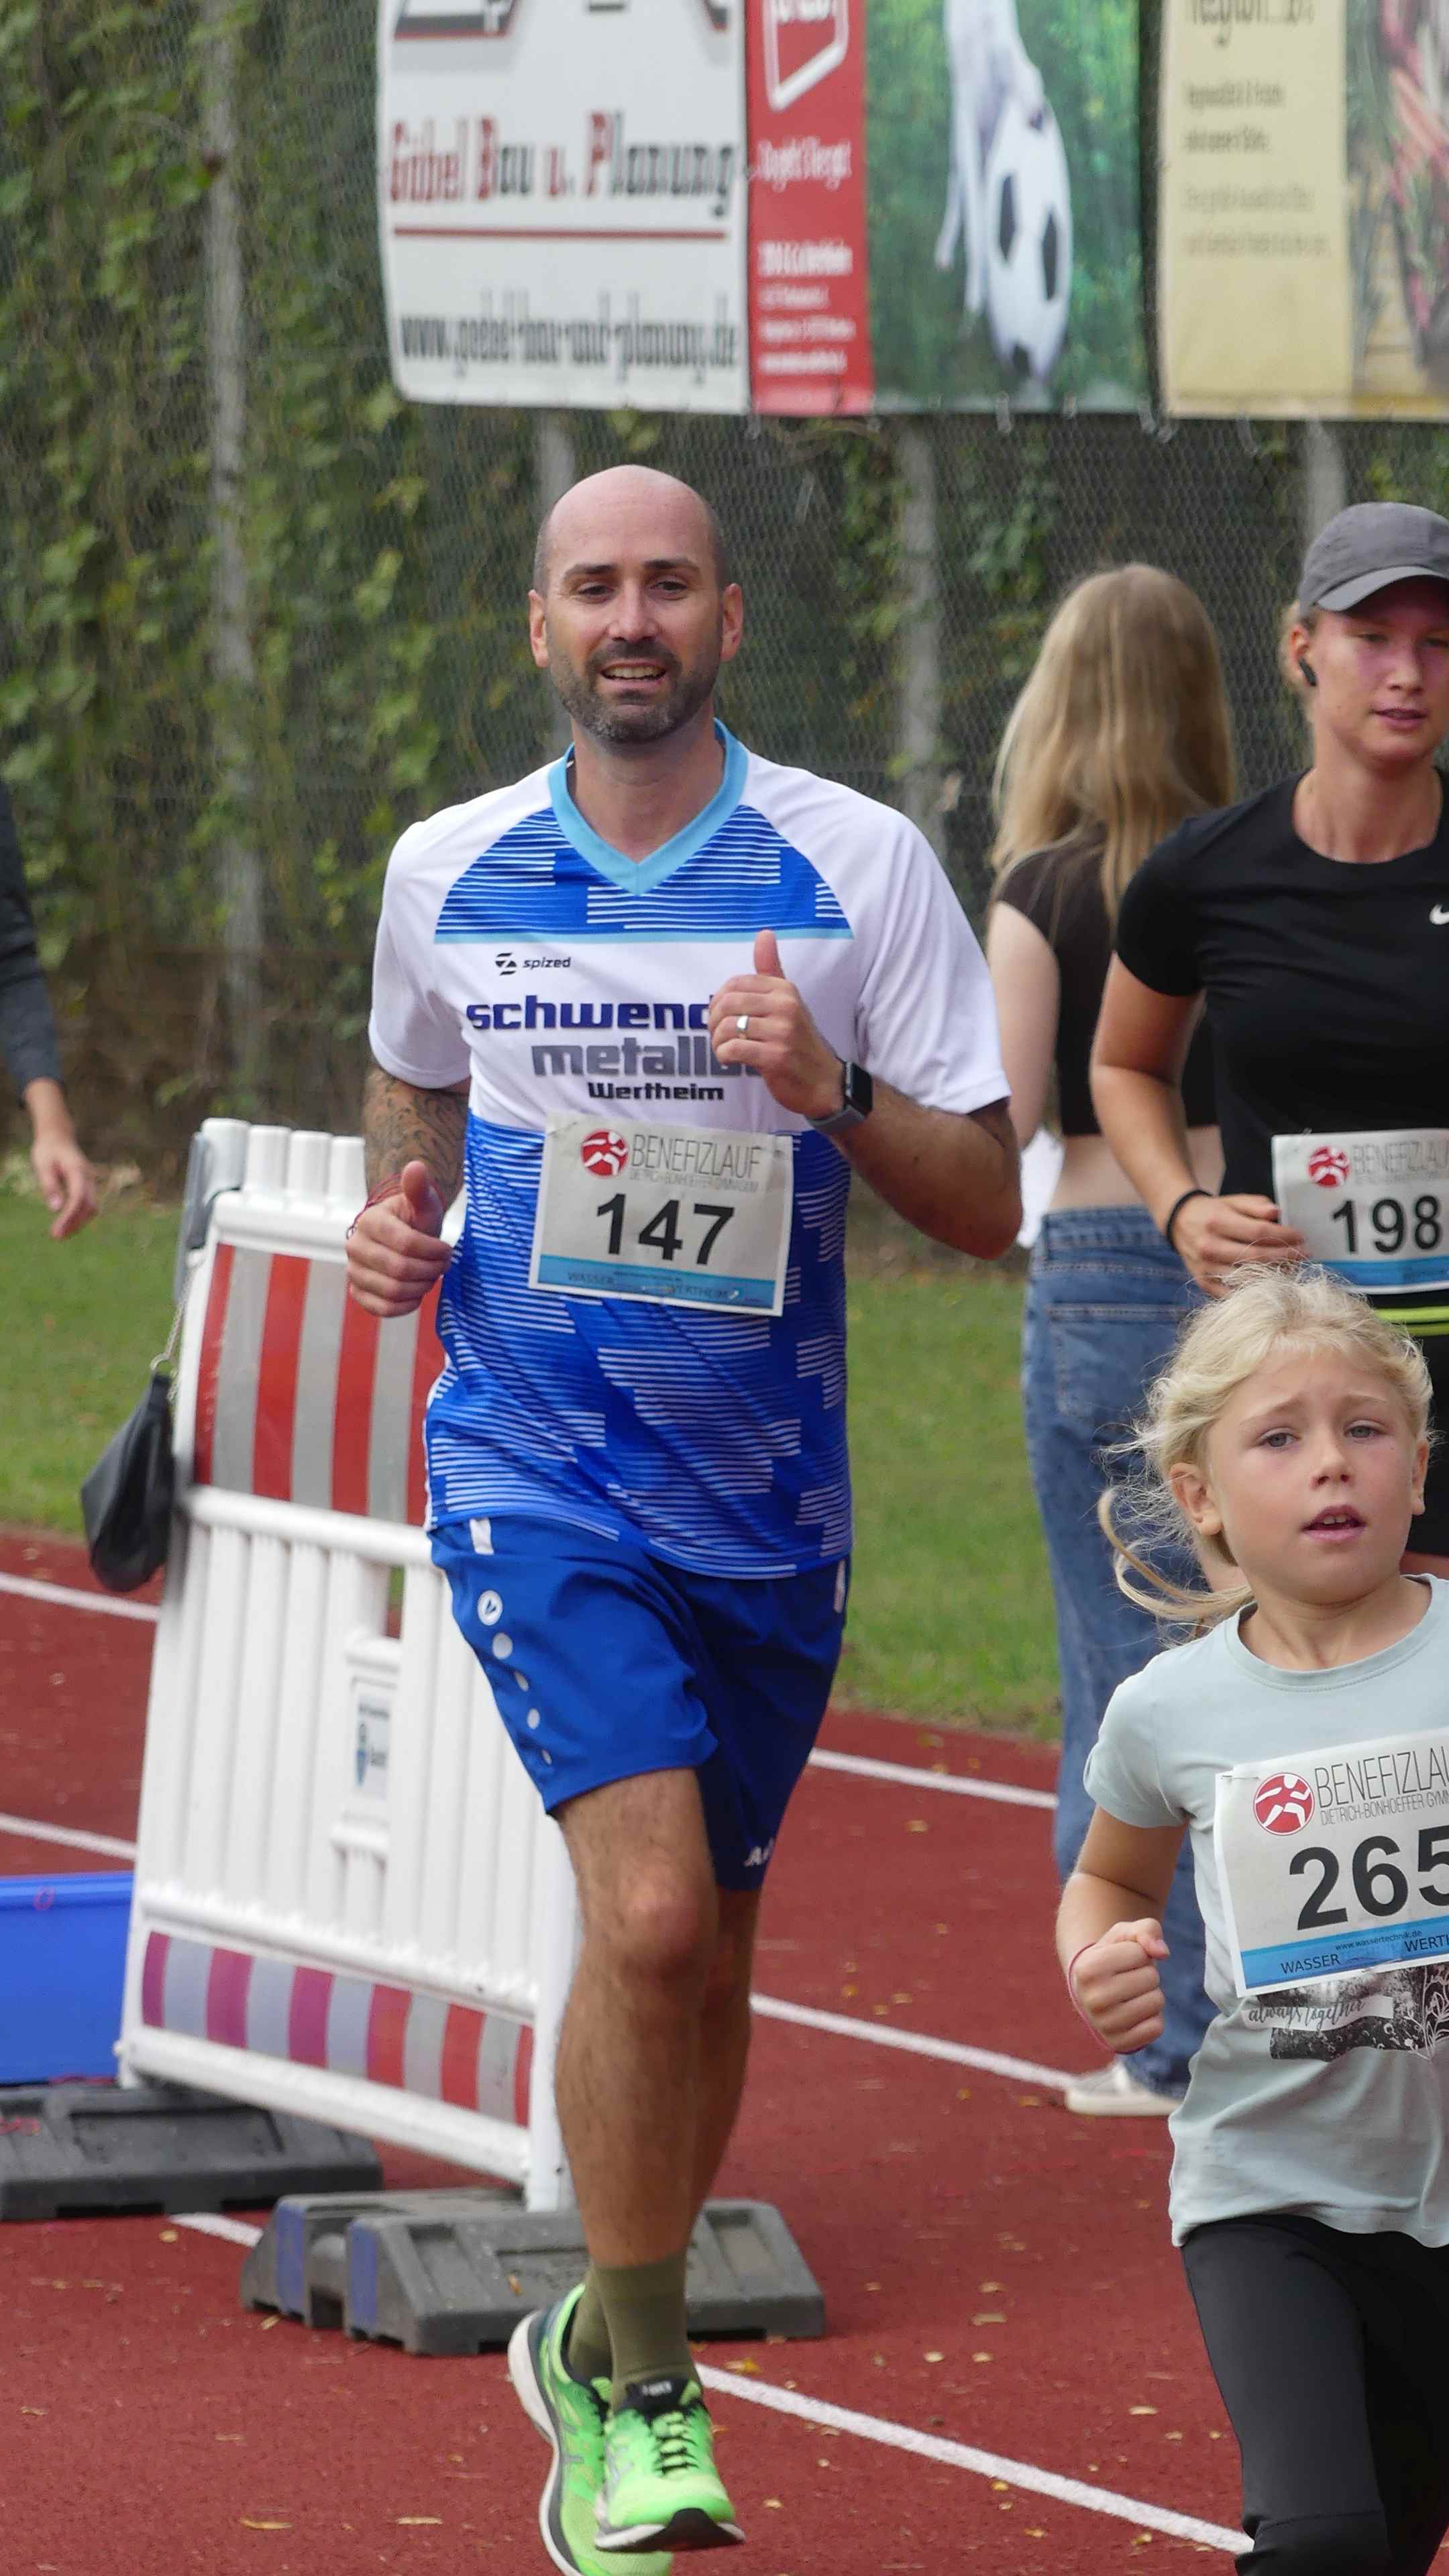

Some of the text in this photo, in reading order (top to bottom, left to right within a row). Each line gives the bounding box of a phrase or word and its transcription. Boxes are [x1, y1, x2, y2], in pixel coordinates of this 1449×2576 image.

[476, 114, 535, 201] Bau
[585, 111, 737, 217] Planung
[523, 957, 572, 970] spized
[588, 1081, 724, 1100] Wertheim
[631, 1134, 763, 1179] BENEFIZLAUF
[597, 1193, 735, 1265] 147
[1332, 1194, 1442, 1254] 198
[1321, 1793, 1424, 1825] DIETRICH-BONHOEFFER
[1289, 1825, 1449, 1931] 265
[1281, 1934, 1449, 1974] WASSER WERT
